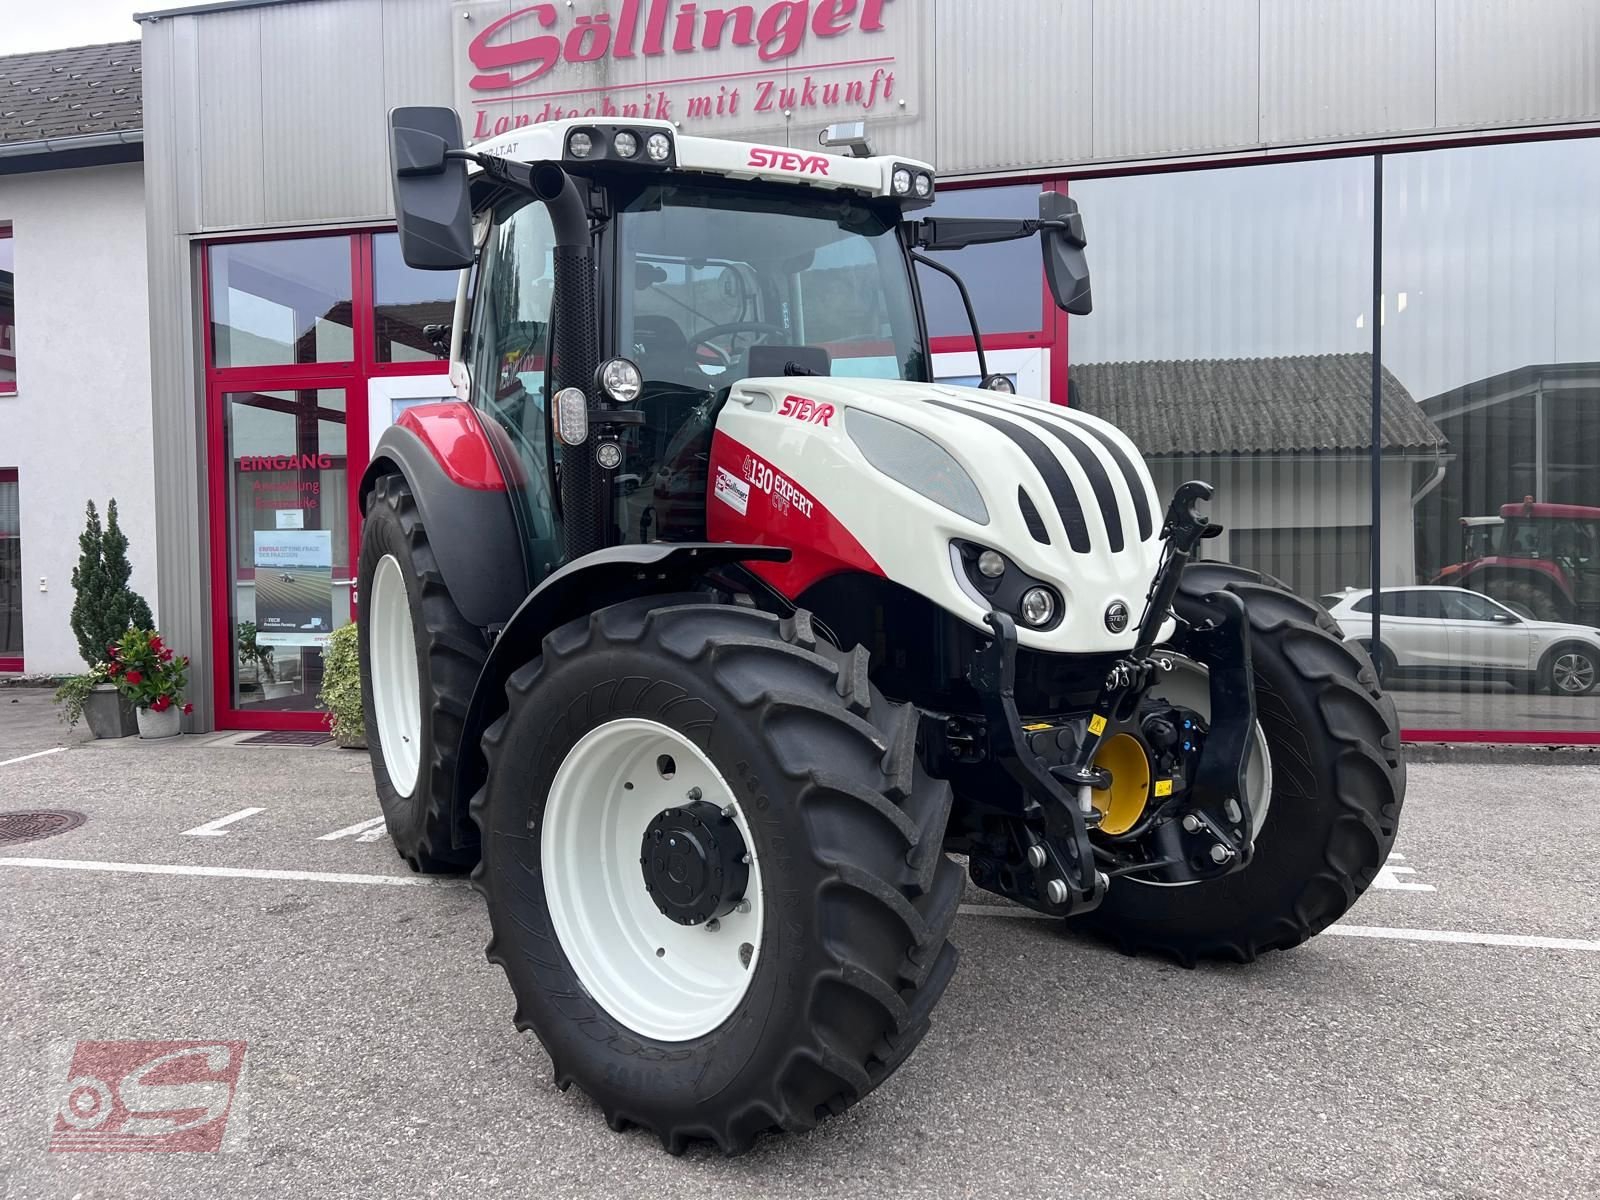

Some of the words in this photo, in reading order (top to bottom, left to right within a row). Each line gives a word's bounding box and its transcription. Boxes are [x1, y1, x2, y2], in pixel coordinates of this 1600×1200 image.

[687, 86, 739, 118] mit
[753, 69, 895, 111] Zukunft
[747, 148, 830, 176] STEYR
[778, 395, 834, 427] STEYR
[240, 454, 332, 471] EINGANG
[742, 455, 774, 495] 4130
[774, 475, 814, 519] EXPERT
[771, 492, 790, 517] CVT
